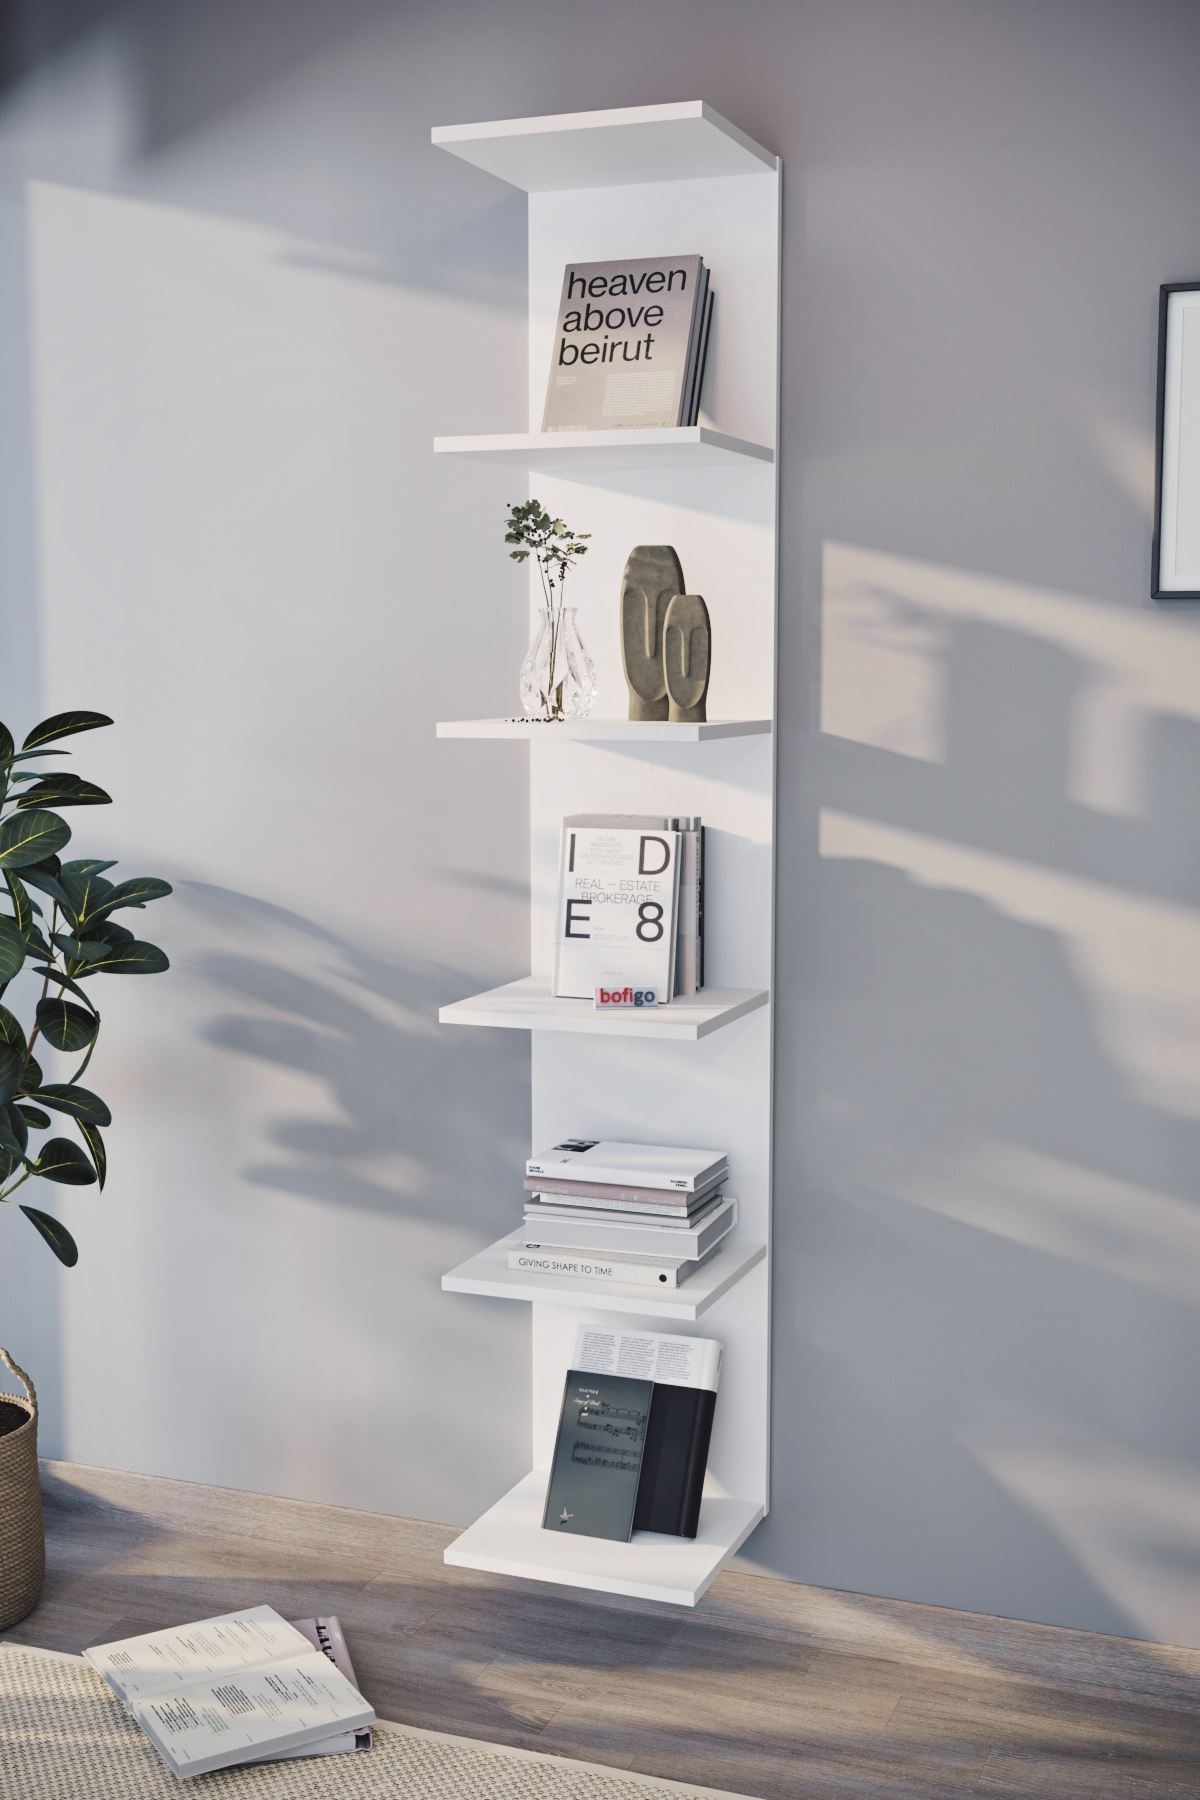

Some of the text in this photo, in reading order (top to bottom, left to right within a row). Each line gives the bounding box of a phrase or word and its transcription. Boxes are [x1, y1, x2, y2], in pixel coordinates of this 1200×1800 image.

[567, 269, 687, 299] heaven
[562, 304, 664, 333] above
[559, 333, 655, 366] beirut
[638, 836, 671, 875] D
[575, 878, 605, 890] REAL
[619, 880, 662, 893] ESTATE
[581, 892, 654, 906] BROKERAGE
[565, 899, 664, 942] E 8
[518, 1257, 613, 1276] GIVING SHAPE TO TIME
